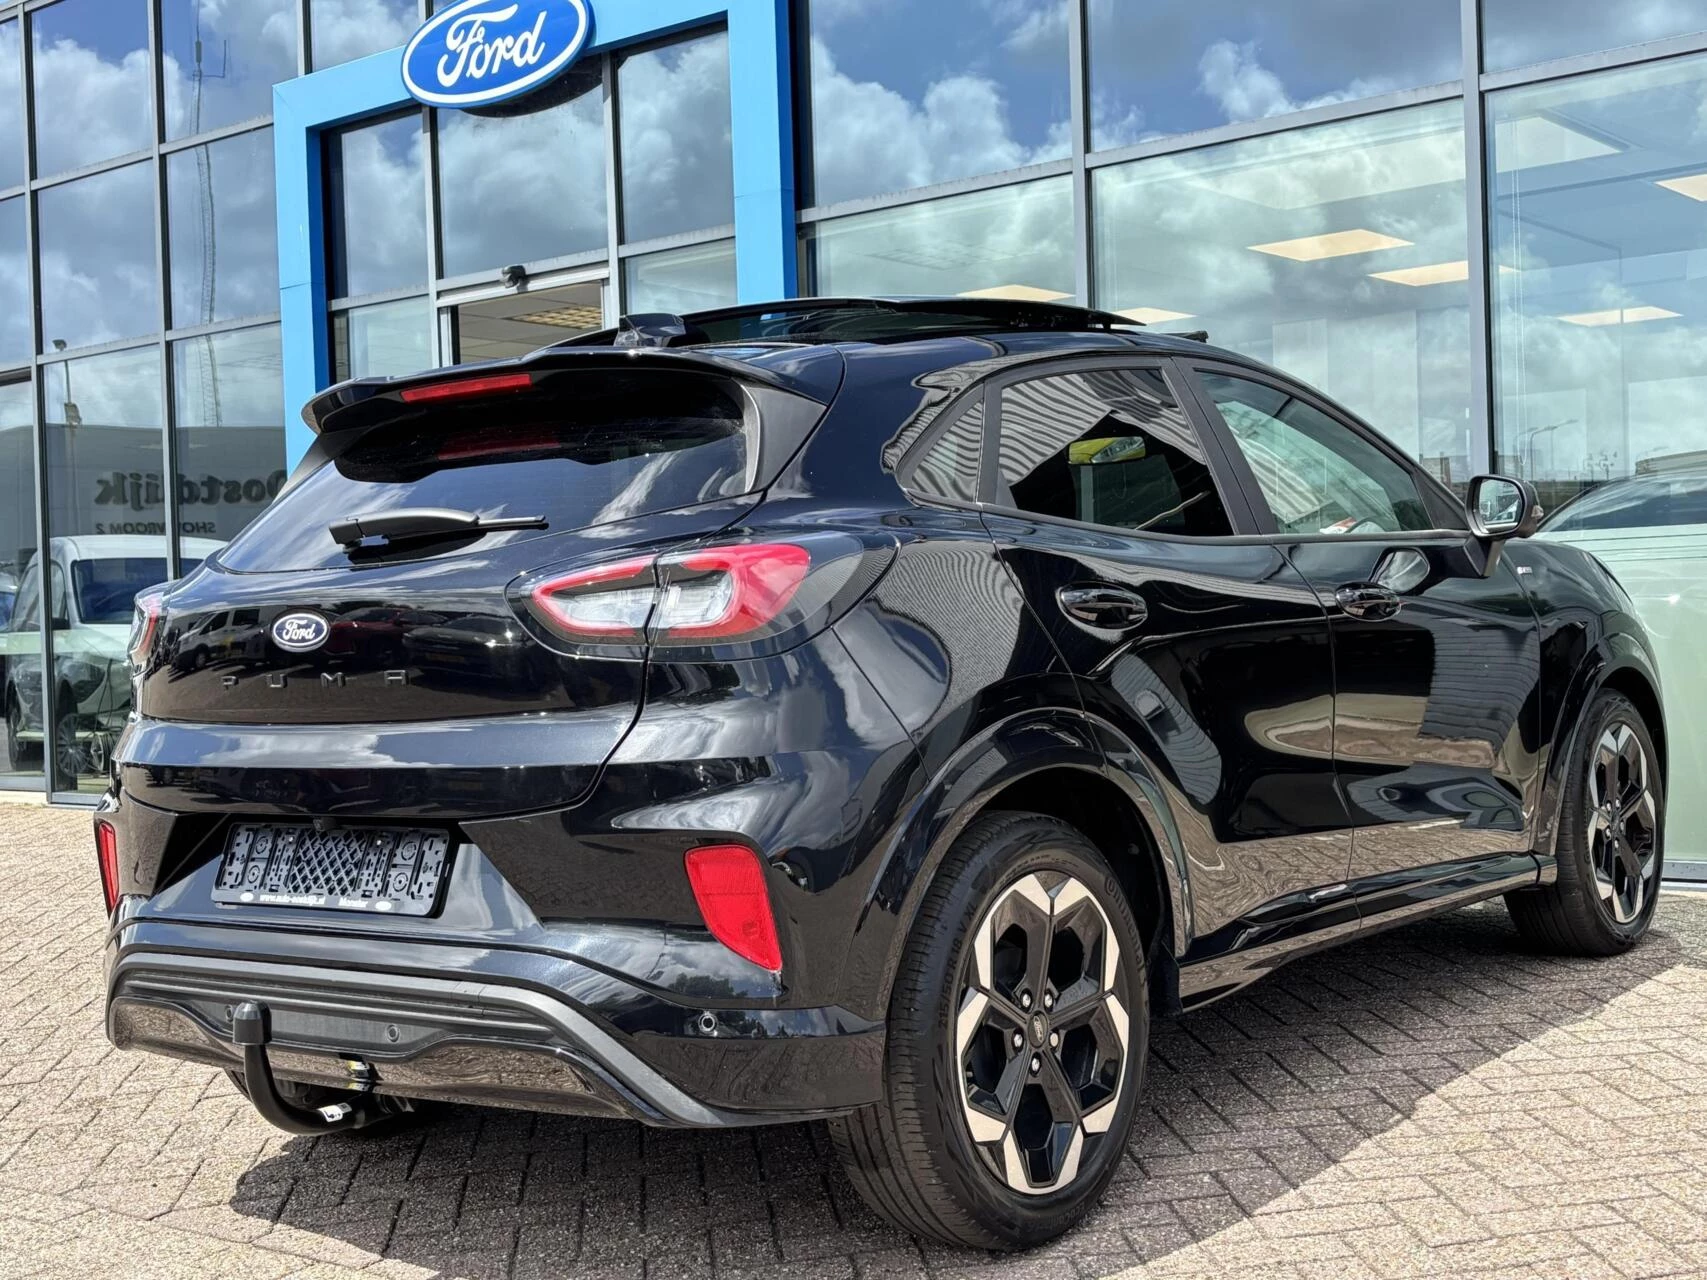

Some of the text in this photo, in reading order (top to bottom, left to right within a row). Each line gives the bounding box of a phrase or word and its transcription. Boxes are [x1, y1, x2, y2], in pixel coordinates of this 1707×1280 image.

[437, 4, 547, 87] Ford
[282, 618, 316, 641] Ford
[220, 669, 409, 691] PUMA
